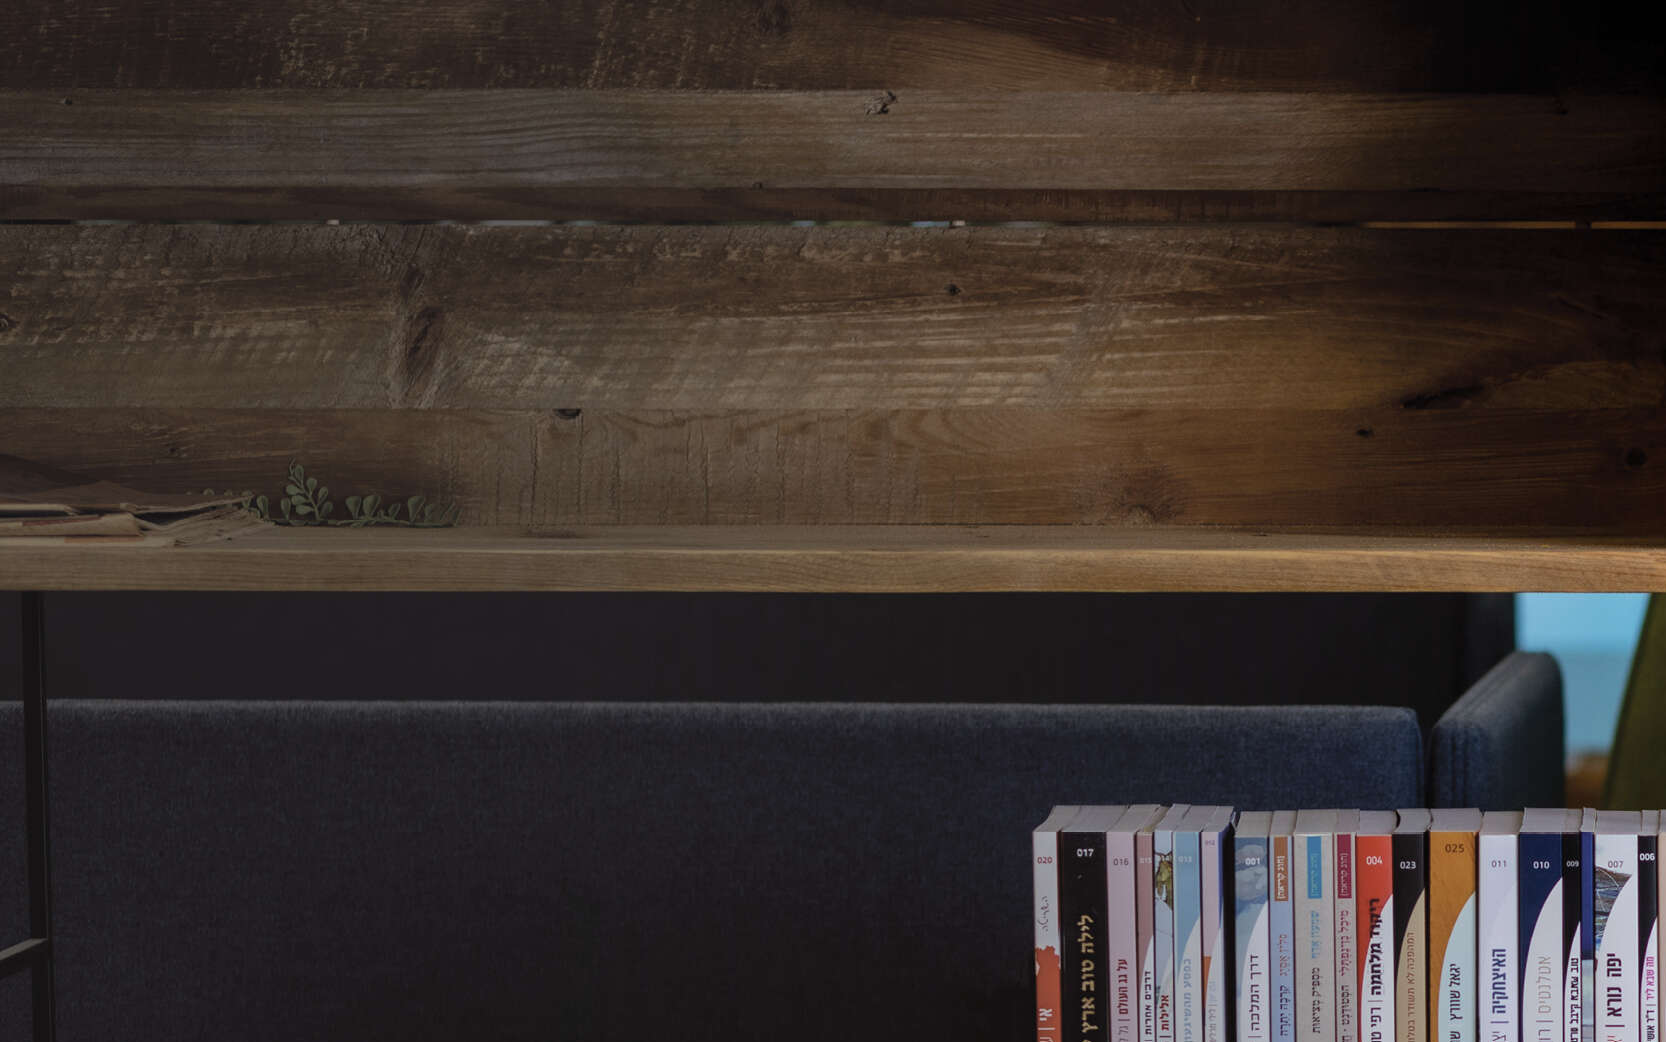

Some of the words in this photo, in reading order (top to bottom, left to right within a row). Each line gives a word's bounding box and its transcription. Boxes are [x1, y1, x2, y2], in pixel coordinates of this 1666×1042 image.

[1077, 848, 1094, 857] 017
[1445, 843, 1465, 853] 025
[1640, 853, 1655, 861] 006
[1037, 856, 1053, 864] 020
[1113, 858, 1129, 866] 016
[1245, 857, 1261, 865] 001
[1366, 855, 1383, 865] 004
[1400, 861, 1416, 869] 023
[1491, 860, 1507, 868] 011
[1533, 861, 1550, 869] 010
[1607, 860, 1624, 868] 007
[1368, 898, 1383, 939] ריקוד
[1077, 914, 1094, 953] לילה
[1407, 932, 1416, 970] המהפכה
[1116, 959, 1128, 971] על
[1248, 954, 1262, 976] דרך
[1368, 943, 1383, 996] מלחמה
[1570, 958, 1579, 972] טוב
[1606, 953, 1622, 978] יפה
[1646, 956, 1655, 967] מה
[1080, 959, 1095, 992] טוב
[1118, 974, 1129, 984] גג
[1406, 972, 1416, 985] לא
[1448, 963, 1462, 987] יגאל
[1491, 948, 1509, 1014] האיצחקיה
[1646, 969, 1655, 986] שבא
[1536, 956, 1552, 1014] אטלנטיס
[1570, 976, 1579, 1001] שאבא
[1117, 986, 1129, 1015] העולם
[1407, 988, 1416, 1017] תשודר
[1606, 987, 1623, 1017] נורא
[1645, 988, 1655, 1001] ליד
[1039, 1008, 1052, 1021] אי
[1080, 996, 1099, 1033] ארץ
[1159, 995, 1170, 1031] אלילות
[1247, 984, 1261, 1031] המלכה
[1449, 990, 1463, 1021] שוורץ
[1569, 1004, 1581, 1024] קיבל
[1144, 1005, 1153, 1035] אחרות
[1371, 1007, 1382, 1028] רפי
[1118, 1025, 1129, 1036] גל
[1646, 1025, 1655, 1042] אושי
